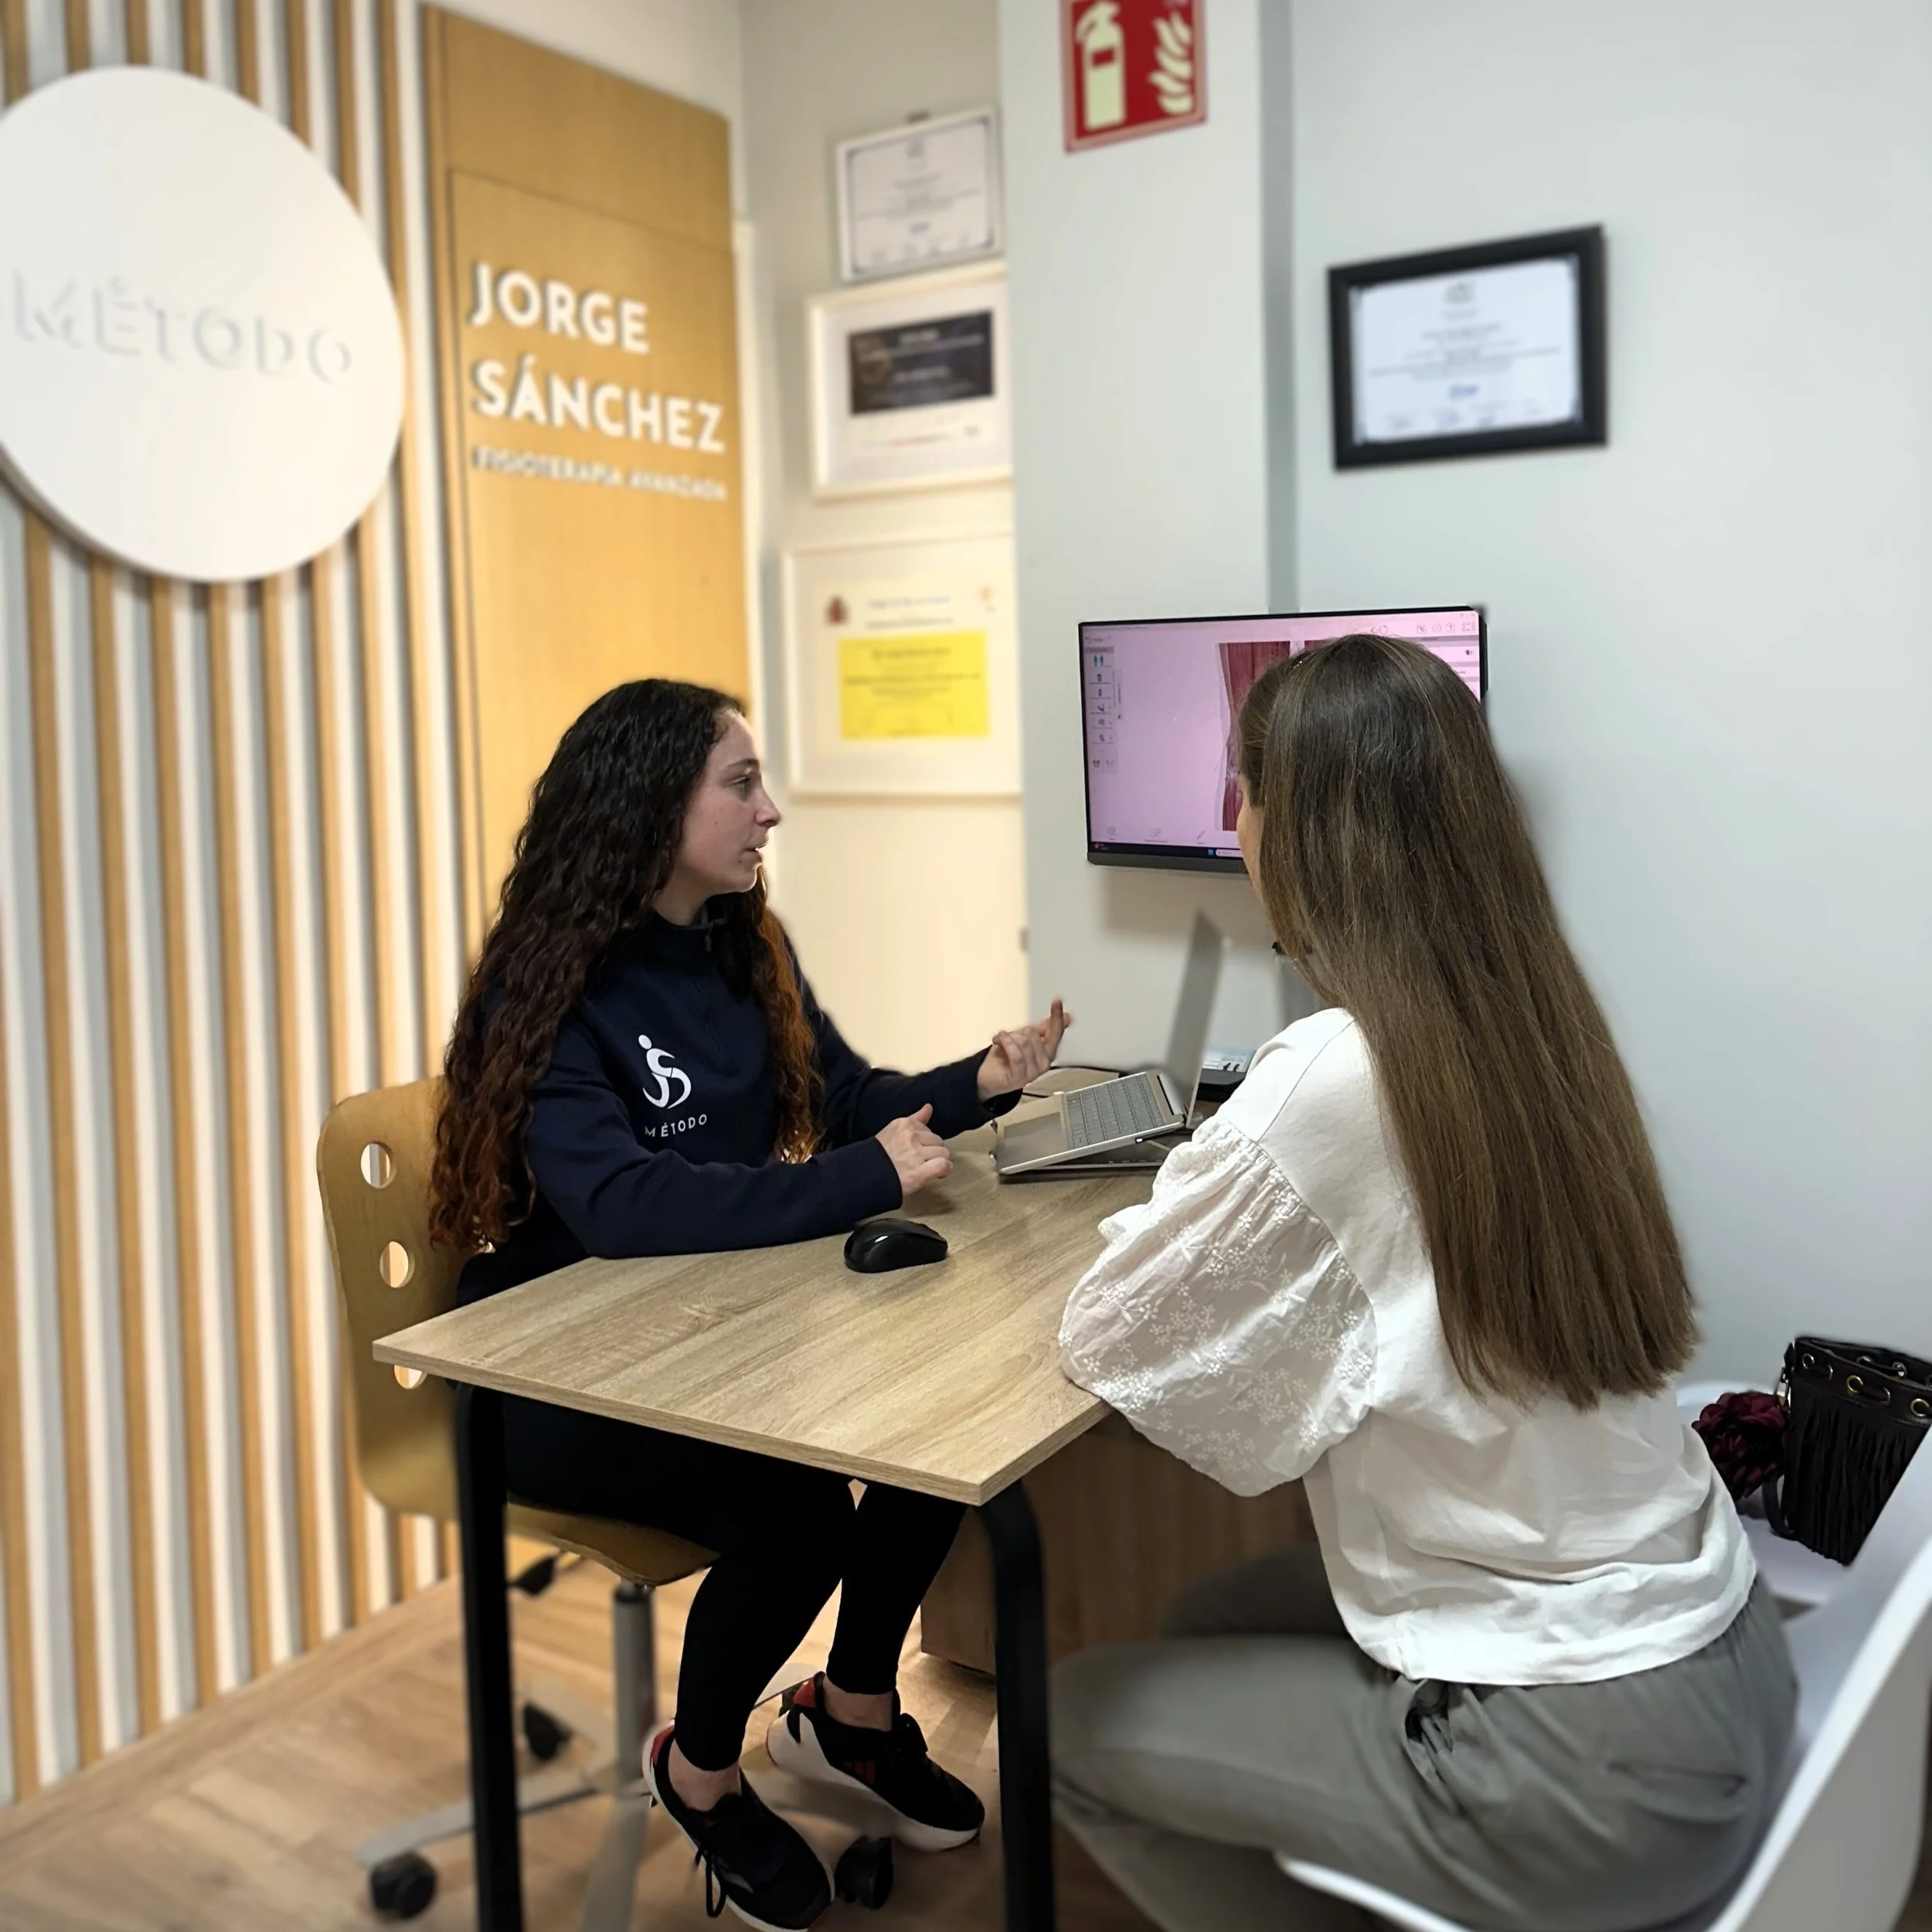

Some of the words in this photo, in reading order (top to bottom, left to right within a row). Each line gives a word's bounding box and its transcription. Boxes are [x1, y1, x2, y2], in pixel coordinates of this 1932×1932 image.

[468, 261, 651, 353] JORGE
[472, 354, 726, 454] SÁNCHEZ
[645, 1114, 707, 1138] MÉTODO
